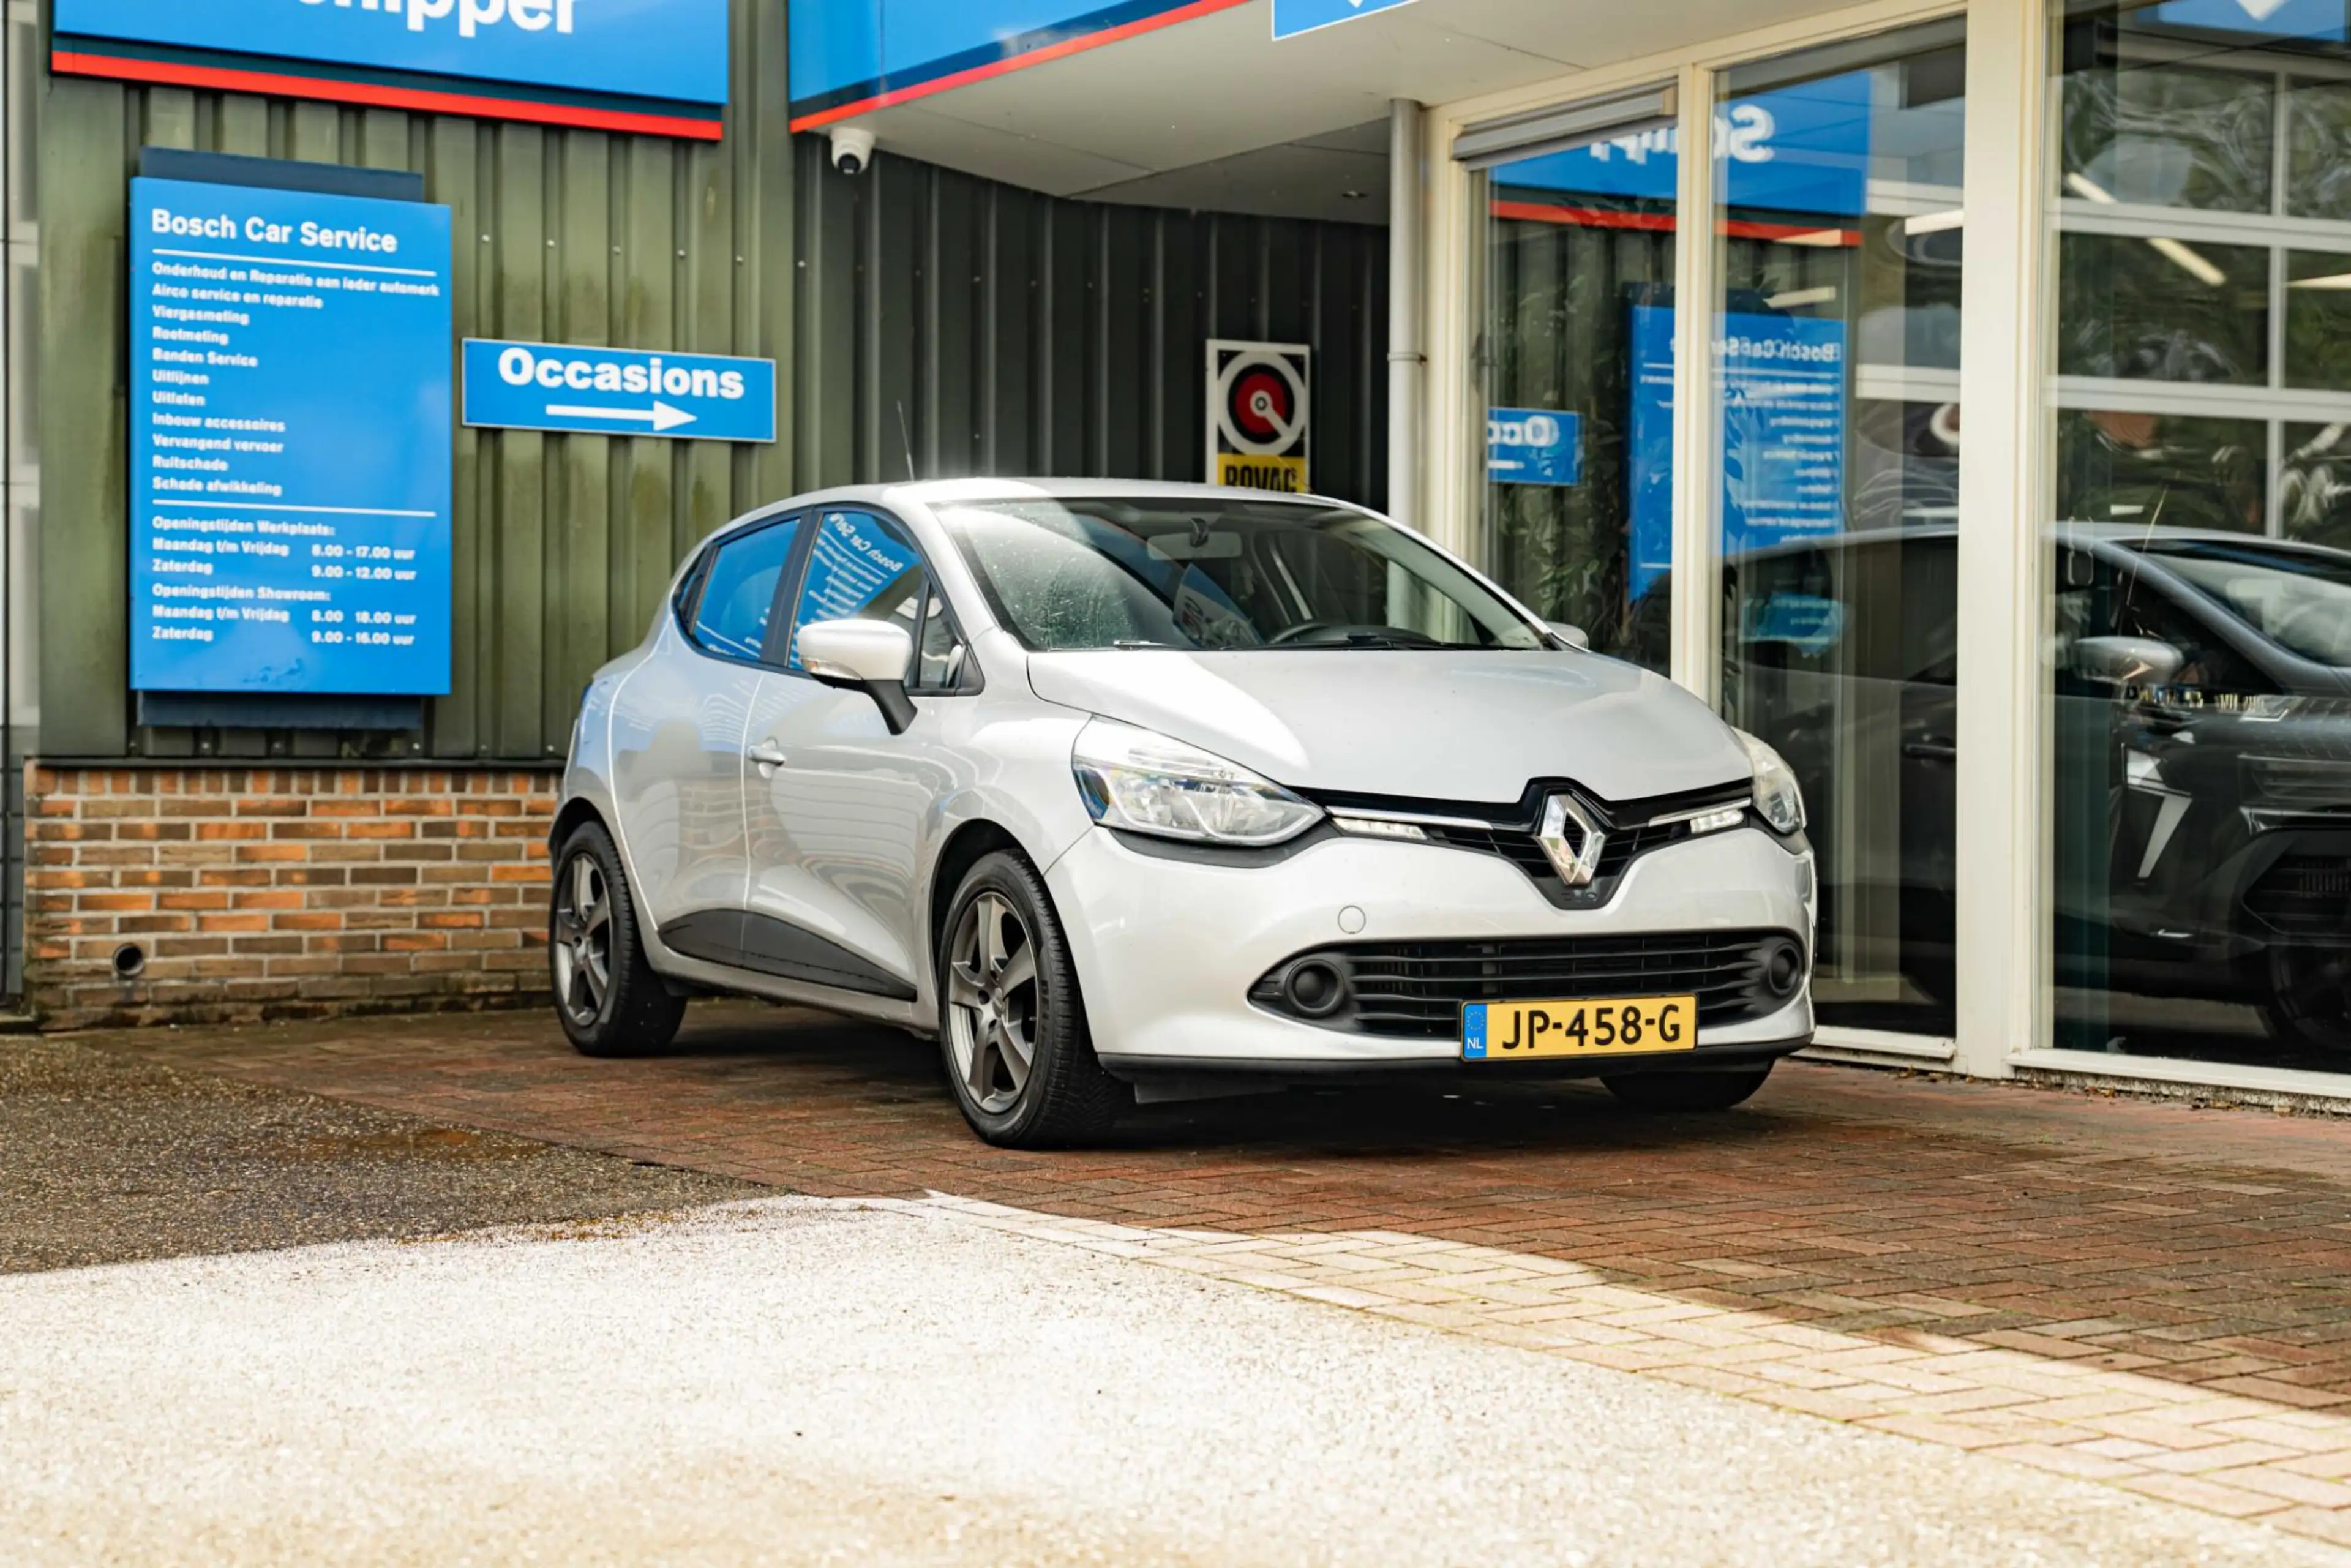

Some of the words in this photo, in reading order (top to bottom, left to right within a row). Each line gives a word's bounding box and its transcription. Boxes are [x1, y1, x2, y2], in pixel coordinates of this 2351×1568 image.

[152, 208, 237, 239] Bosch
[245, 216, 293, 244] Car
[300, 221, 397, 253] Service
[152, 261, 227, 280] Onderhoud
[230, 270, 247, 281] en
[250, 269, 313, 287] Reparatie
[343, 277, 377, 291] ieder
[152, 283, 188, 298] Airco
[192, 288, 240, 302] service
[243, 293, 260, 303] en
[263, 294, 323, 309] reparatie
[152, 347, 204, 363] Banden
[207, 351, 258, 367] Service
[498, 347, 745, 399] Occasions
[152, 412, 201, 427] Inbouw
[205, 418, 285, 432] accessoires
[152, 433, 231, 451] Vervangend
[234, 440, 283, 452] vervoer
[152, 454, 228, 471] Ruitschade
[152, 476, 203, 491] Schade
[152, 516, 253, 533] Openingstijden
[152, 537, 213, 554] Maandag
[217, 540, 238, 553] t/m
[242, 541, 290, 557] Vrijdag
[312, 544, 343, 558] 8.00
[356, 546, 391, 559] 17.00
[393, 549, 414, 560] uur
[152, 558, 213, 576] Zaterdag
[312, 564, 343, 579] 9.00
[356, 566, 392, 580] 12.00
[394, 570, 416, 580] uur
[152, 583, 253, 600] Openingstijden
[152, 604, 213, 620] Maandag
[217, 607, 238, 620] t/m
[242, 606, 290, 623] Vrijdag
[312, 610, 343, 623] 8.00
[394, 615, 416, 625] uur
[152, 625, 213, 642] Zaterdag
[312, 630, 343, 643] 9.00
[392, 636, 414, 645] uur
[1502, 1004, 1680, 1051] JP-458-G
[1466, 1037, 1483, 1049] NL
